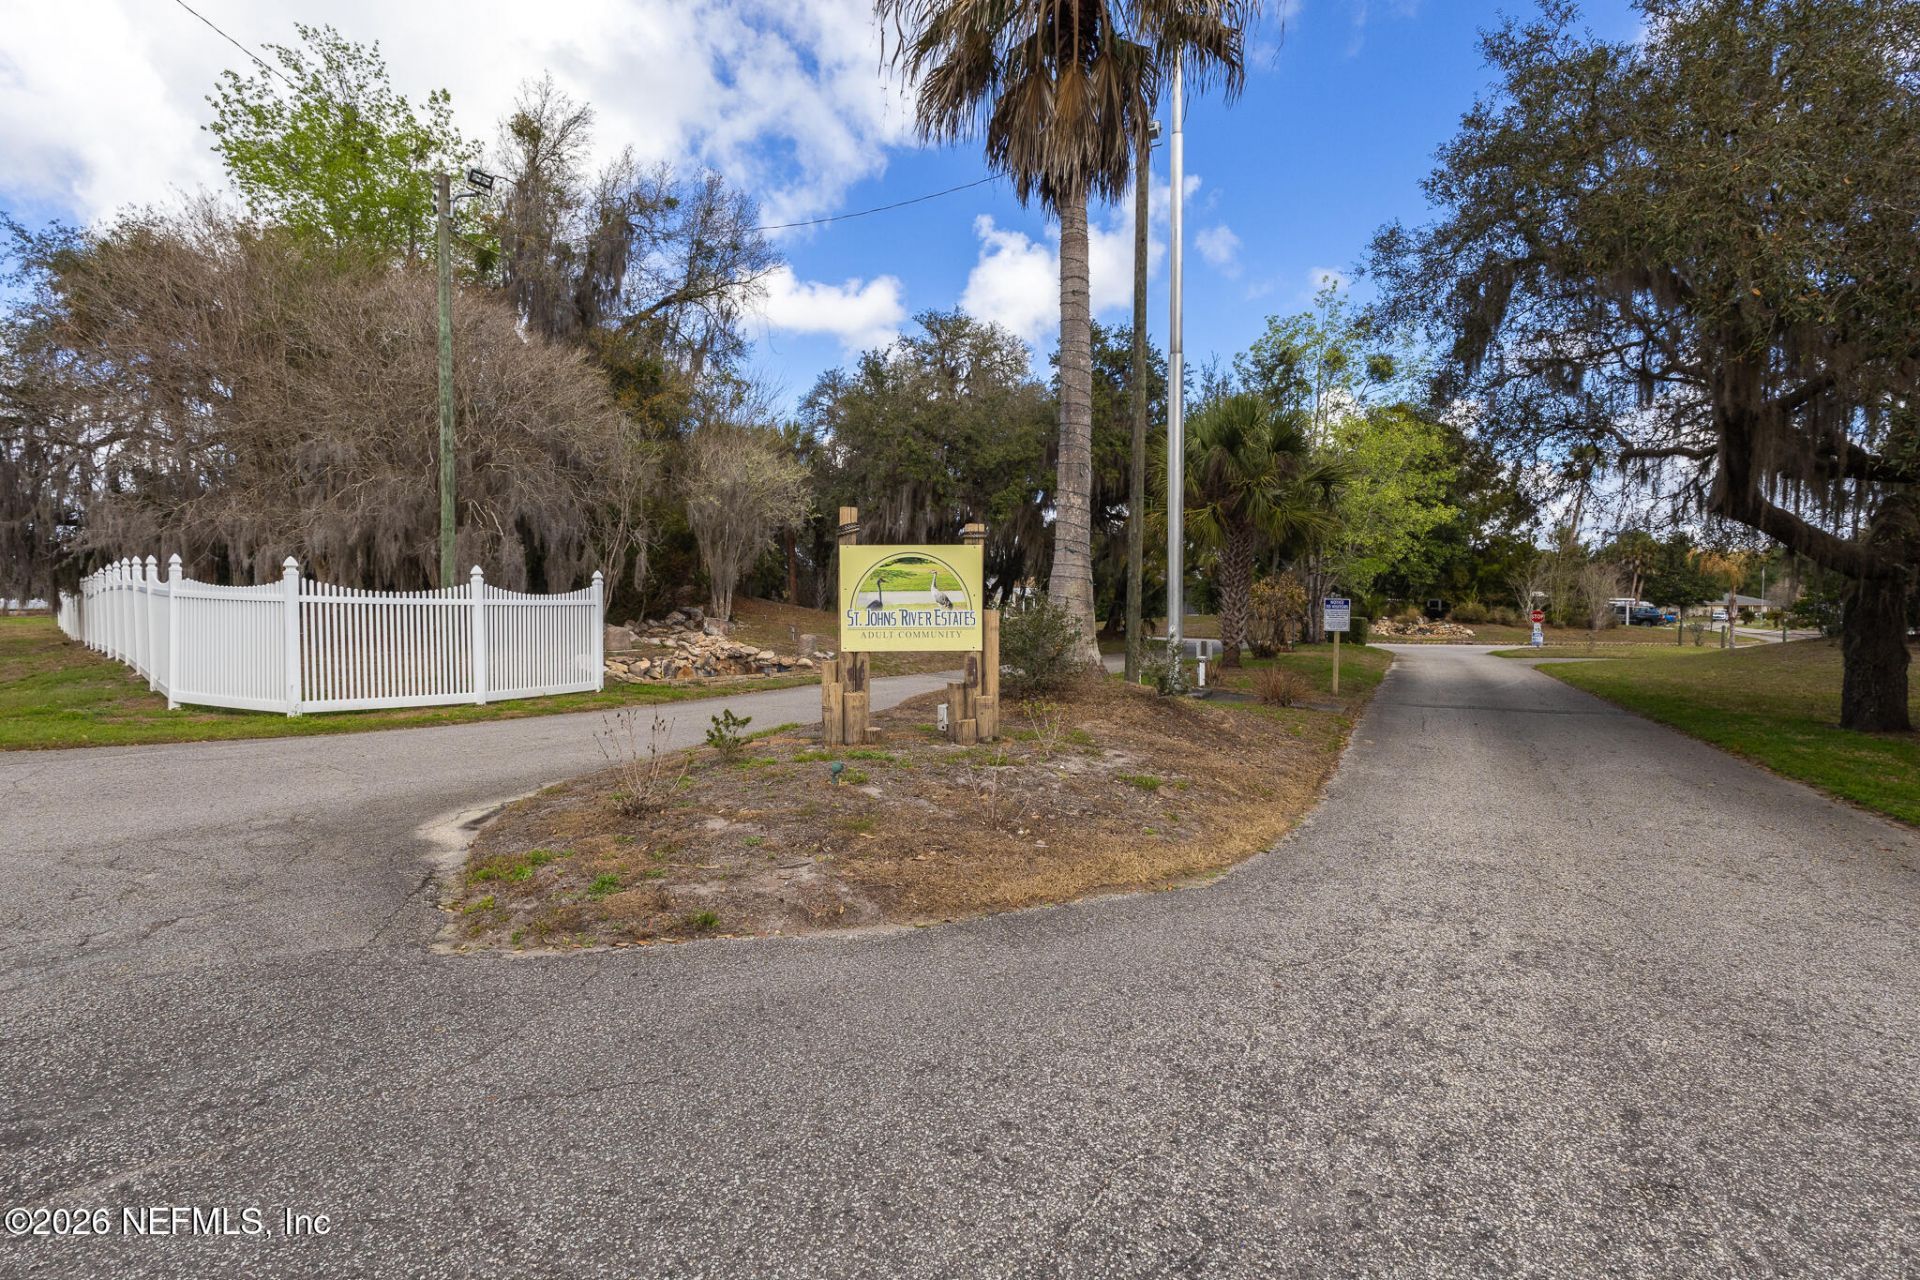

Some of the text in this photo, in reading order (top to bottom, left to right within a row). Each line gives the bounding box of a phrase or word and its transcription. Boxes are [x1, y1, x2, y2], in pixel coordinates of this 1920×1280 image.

[847, 609, 976, 626] ST. JOHNS RIVER ESTATES
[861, 630, 962, 639] ADULT COMMUNITY
